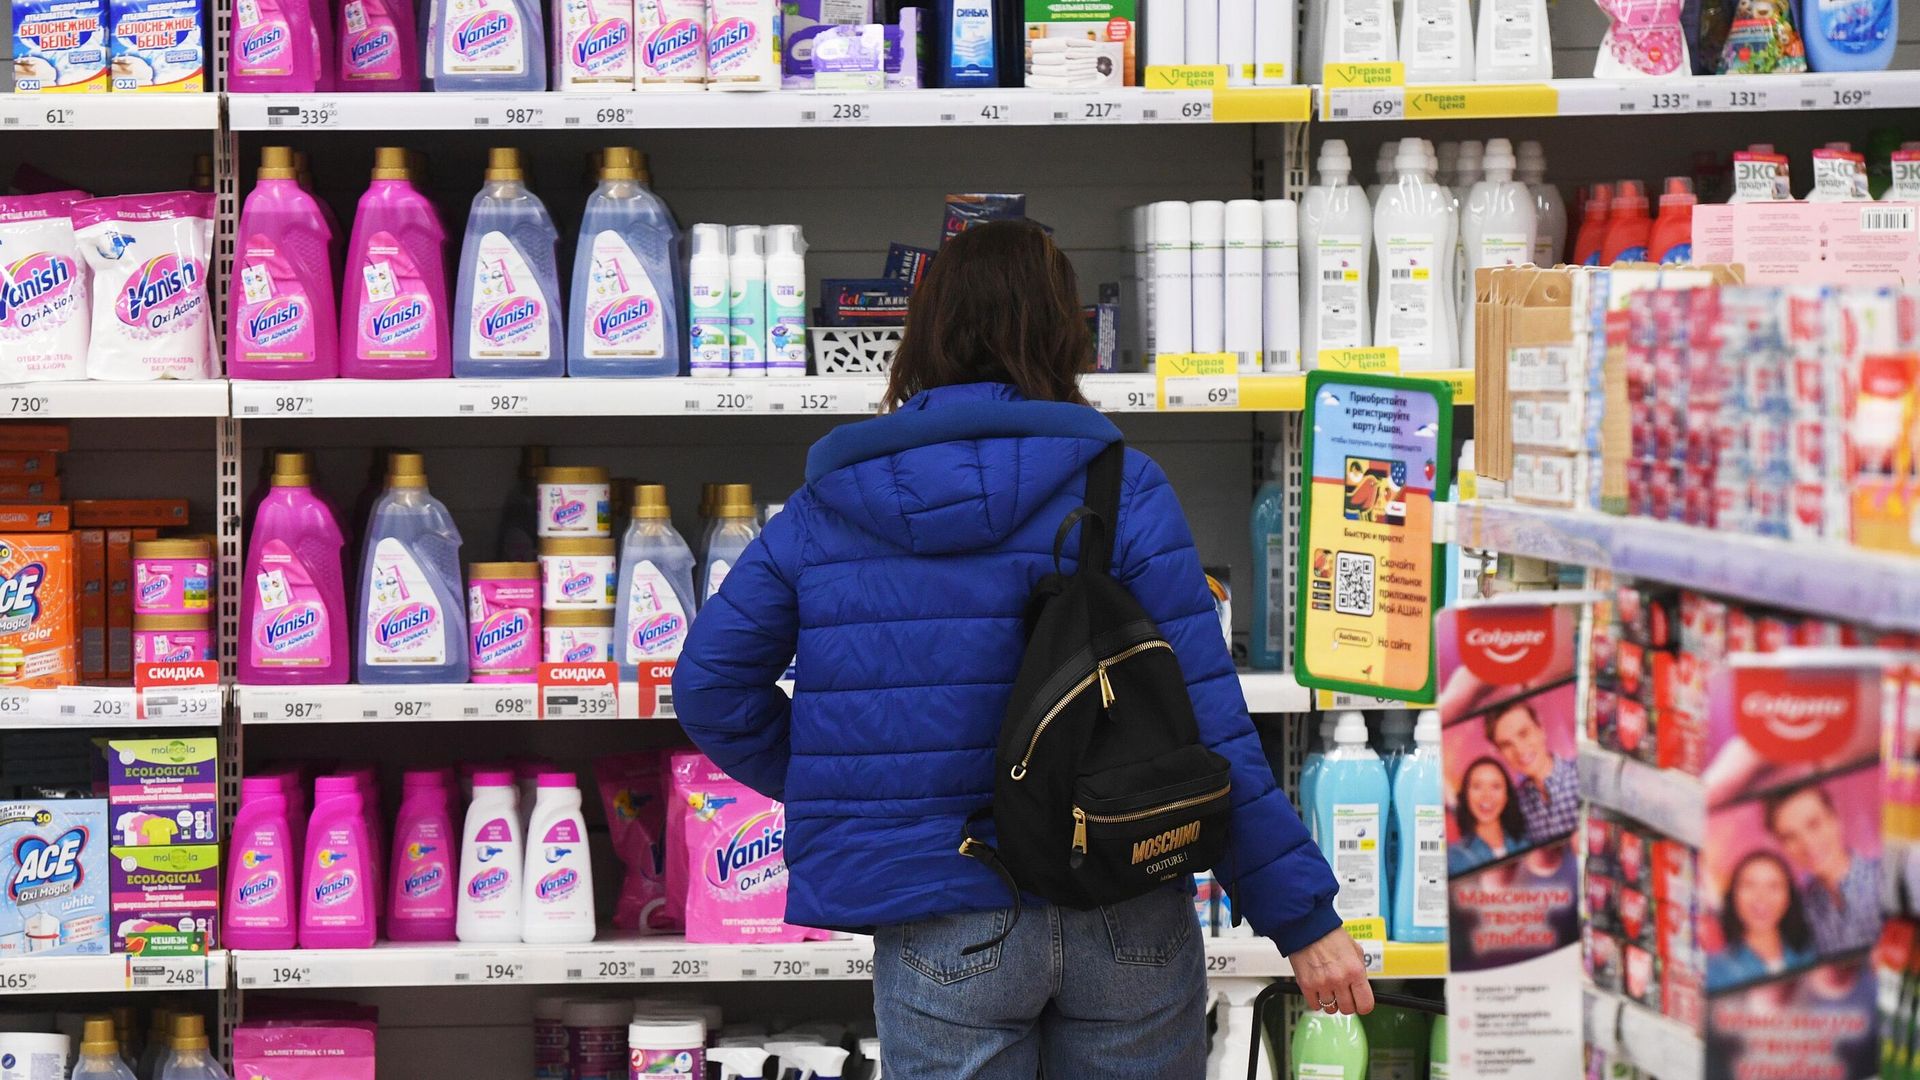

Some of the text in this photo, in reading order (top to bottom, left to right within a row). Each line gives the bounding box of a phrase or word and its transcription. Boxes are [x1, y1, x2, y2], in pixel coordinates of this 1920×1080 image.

[956, 8, 989, 19] СИНЬКА
[20, 17, 98, 37] БЕЛОСНЕЖНОЕ
[117, 17, 196, 36] БЕЛОСНЕЖНОЕ
[458, 15, 507, 50] Vanish
[710, 22, 748, 55] anish
[243, 27, 281, 57] Vanish
[351, 33, 389, 61] Vanish
[578, 23, 627, 62] Vanish
[649, 24, 698, 63] Vanish
[1171, 68, 1214, 79] Первая
[1349, 66, 1392, 77] Первая
[19, 80, 40, 90] OXI
[115, 79, 136, 89] OXI
[1424, 93, 1466, 103] Первая
[128, 260, 196, 320] Vanish
[21, 295, 74, 328] Oxi Ation
[151, 296, 201, 329] Oxi Action
[250, 303, 298, 338] Vanish
[373, 302, 421, 336] Vanish
[486, 302, 534, 336] Vanish
[600, 300, 648, 335] Vanish
[1181, 357, 1225, 368] Первая
[1343, 352, 1386, 362] Первая
[1352, 421, 1376, 433] карту
[0, 573, 39, 614] CE
[381, 607, 429, 641] Vanish
[1397, 606, 1423, 618] АШАН
[21, 627, 52, 643] color
[266, 608, 314, 643] Vanish
[475, 614, 524, 655] Vanish
[639, 616, 678, 646] Vanish
[1466, 627, 1545, 648] Colgate
[148, 666, 205, 681] СКИДКА
[550, 667, 606, 682] СКИДКА
[125, 766, 199, 777] ECOLOGICAL
[37, 814, 51, 822] 30
[717, 828, 784, 881] Vanis
[1131, 820, 1201, 865] MOSCHINO
[15, 840, 80, 884] ACE
[1146, 853, 1184, 875] COUTURE
[127, 874, 202, 884] ECOLOGICAL
[239, 877, 275, 901] Vanish
[315, 877, 350, 900] Vanish
[405, 869, 439, 893] Vanish
[472, 871, 506, 895] Vanish
[541, 872, 574, 896] Vanish
[740, 873, 760, 891] Oxi
[21, 883, 69, 901] Oxi Magic
[62, 895, 95, 910] white
